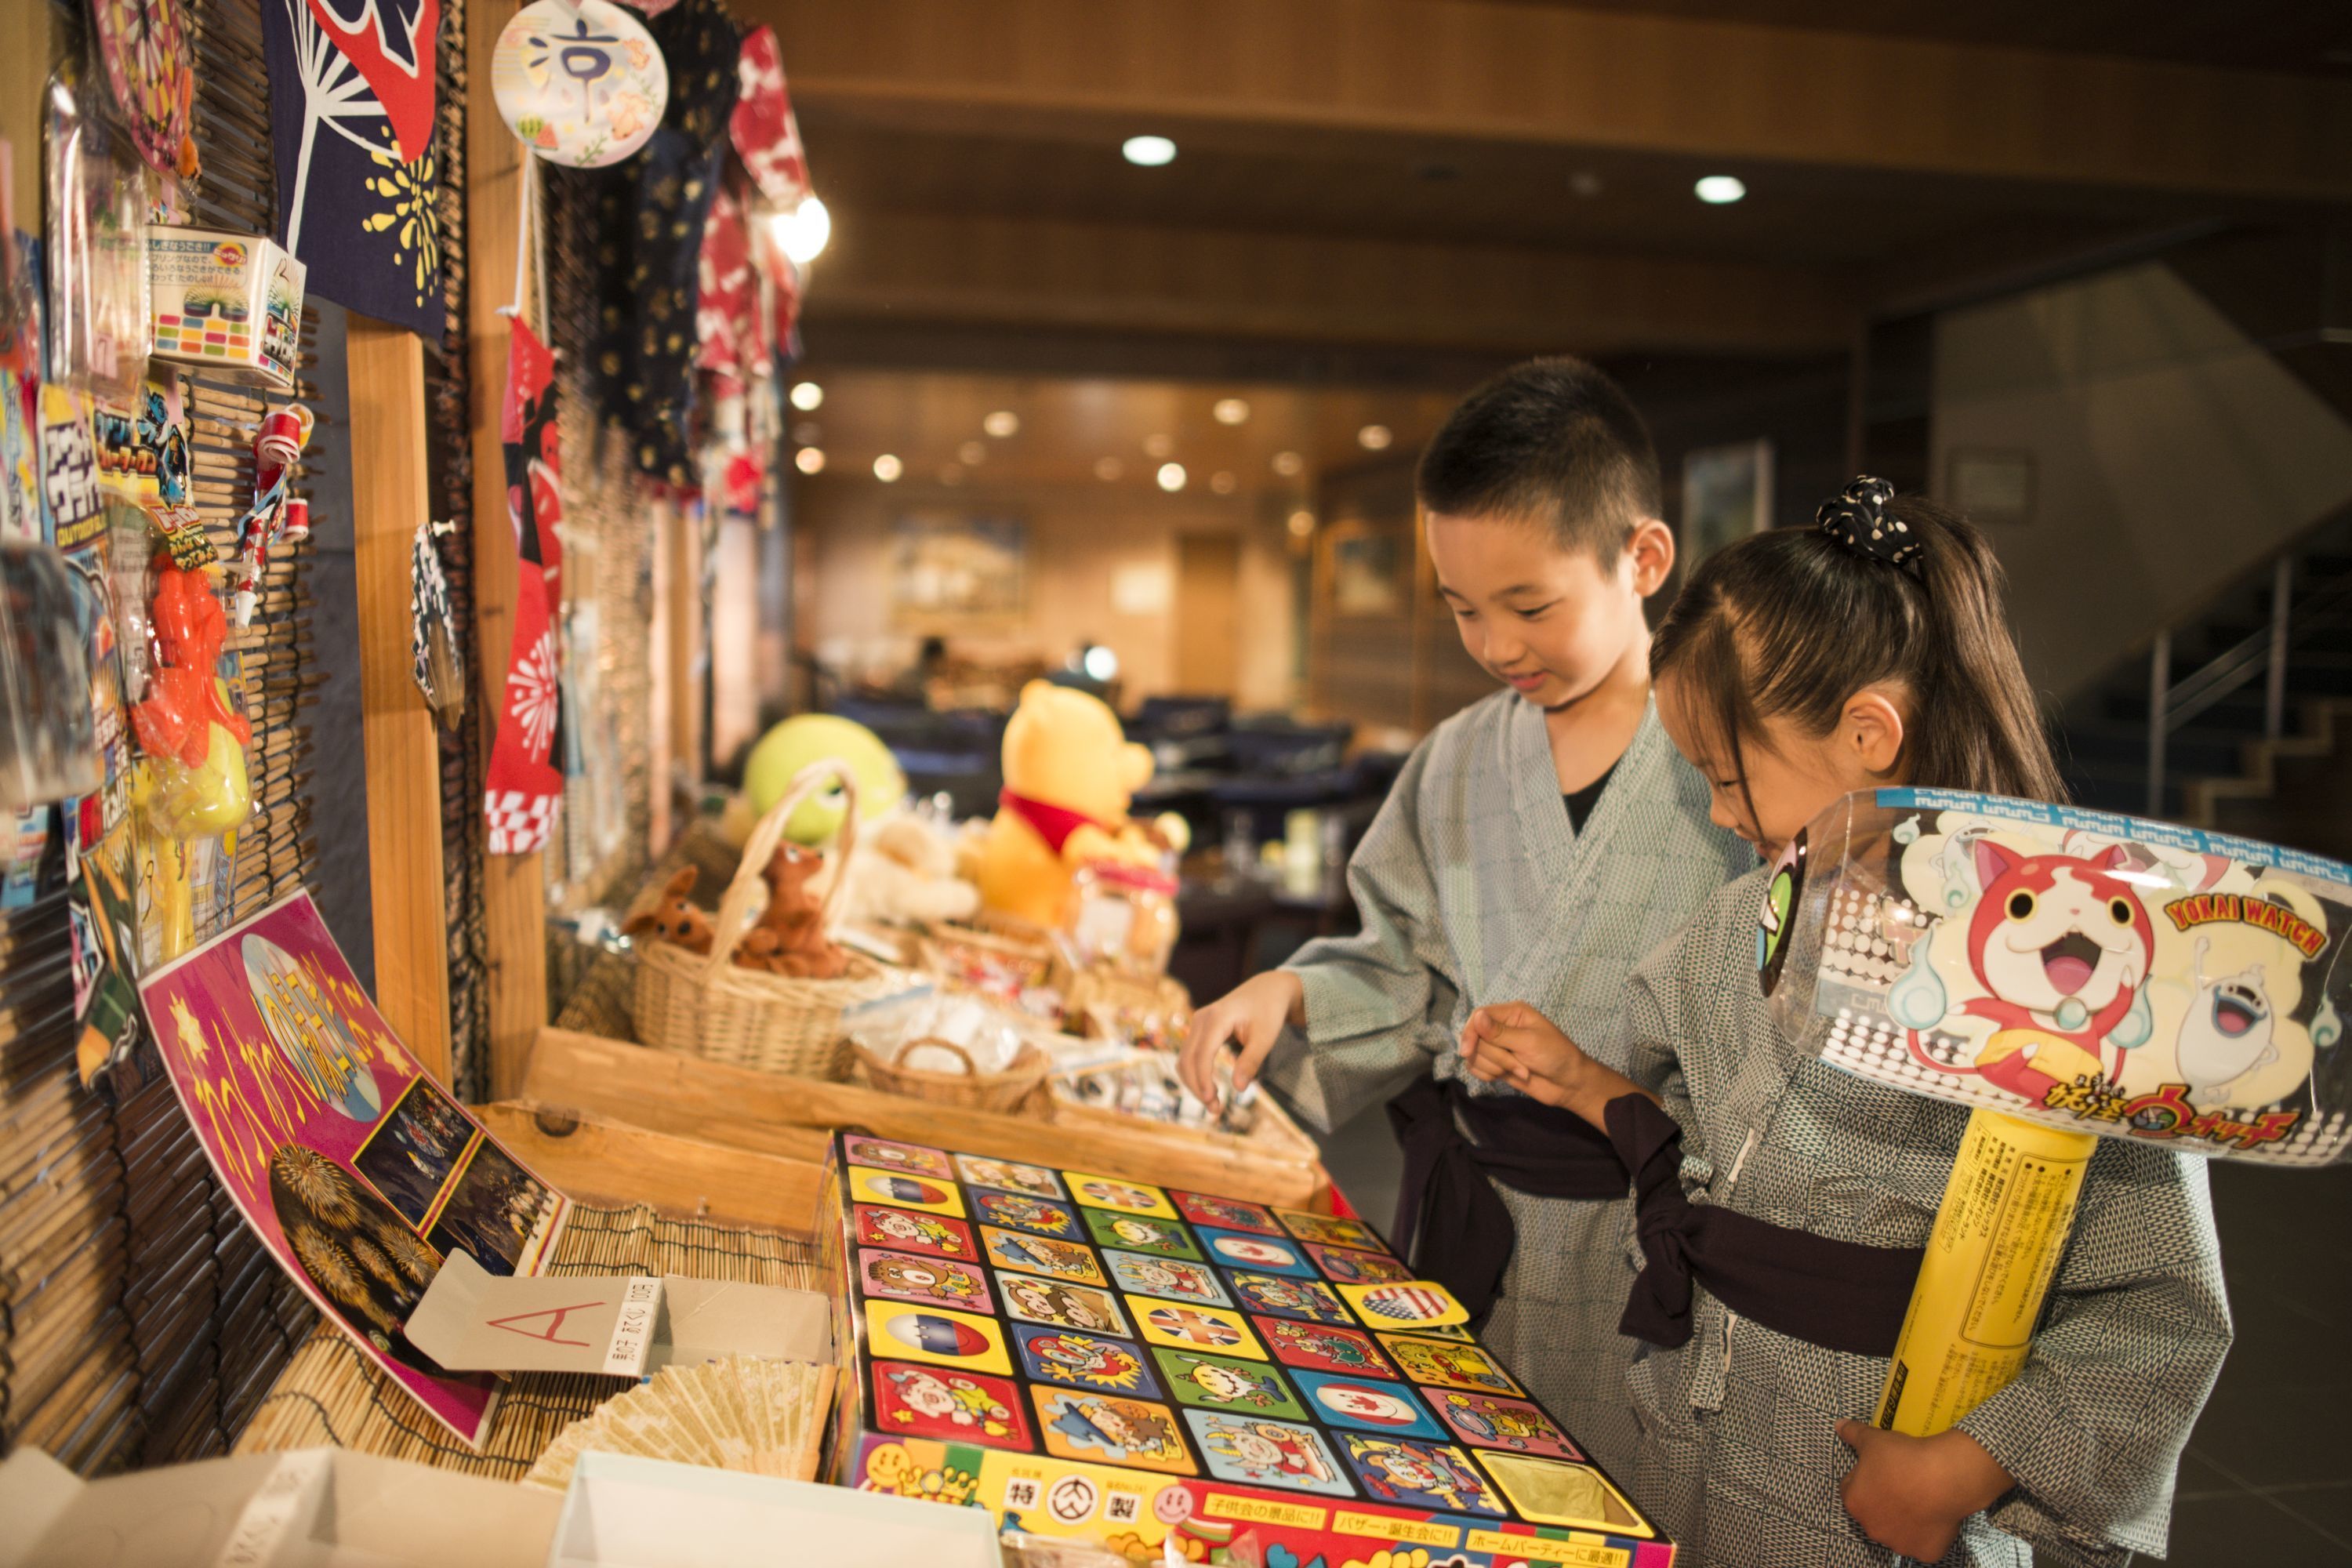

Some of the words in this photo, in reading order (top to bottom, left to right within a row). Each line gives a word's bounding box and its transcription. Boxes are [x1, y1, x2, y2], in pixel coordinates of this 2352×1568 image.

[149, 253, 212, 263] プリングなので、
[149, 264, 244, 275] ろいろなうごきができる。
[2165, 893, 2241, 932] YOKAI
[2241, 895, 2328, 959] WATCH
[630, 1283, 653, 1302] 100円
[486, 1301, 608, 1348] A
[621, 1308, 646, 1335] あてくじ
[612, 1339, 638, 1362] 男の子
[1009, 1483, 1036, 1505] 特
[1109, 1496, 1136, 1519] 製
[1210, 1497, 1320, 1526] 子供会の景品に!!
[1472, 1534, 1624, 1566] ホームパーティーに最適!!
